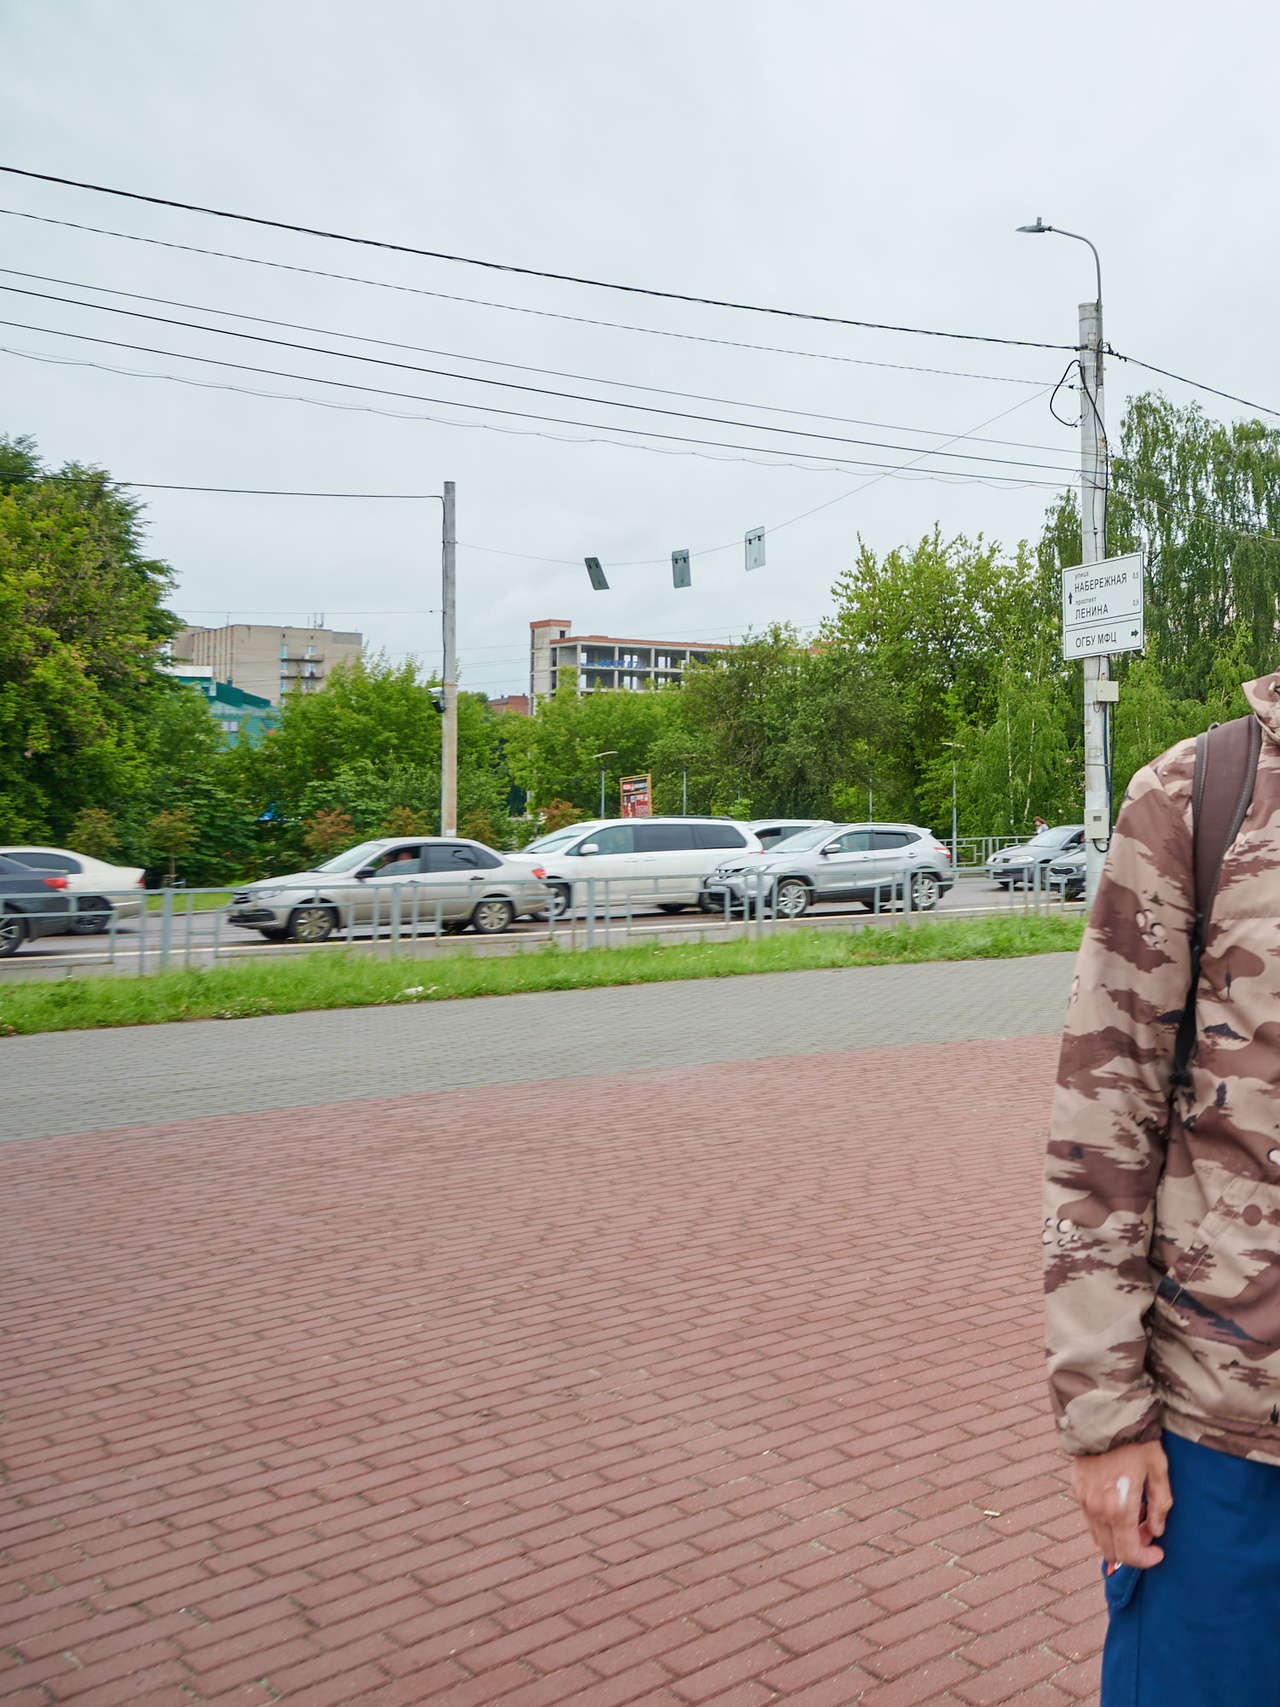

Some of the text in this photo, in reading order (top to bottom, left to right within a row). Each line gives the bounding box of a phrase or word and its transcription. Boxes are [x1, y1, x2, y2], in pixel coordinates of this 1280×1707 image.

[1075, 572, 1089, 580] улица
[1075, 573, 1127, 593] НАБЕРЕЖНАЯ
[1075, 597, 1097, 605] проспект
[1075, 604, 1109, 619] ЛЕНИНА
[1075, 632, 1117, 648] ОГБУ МФЦ
